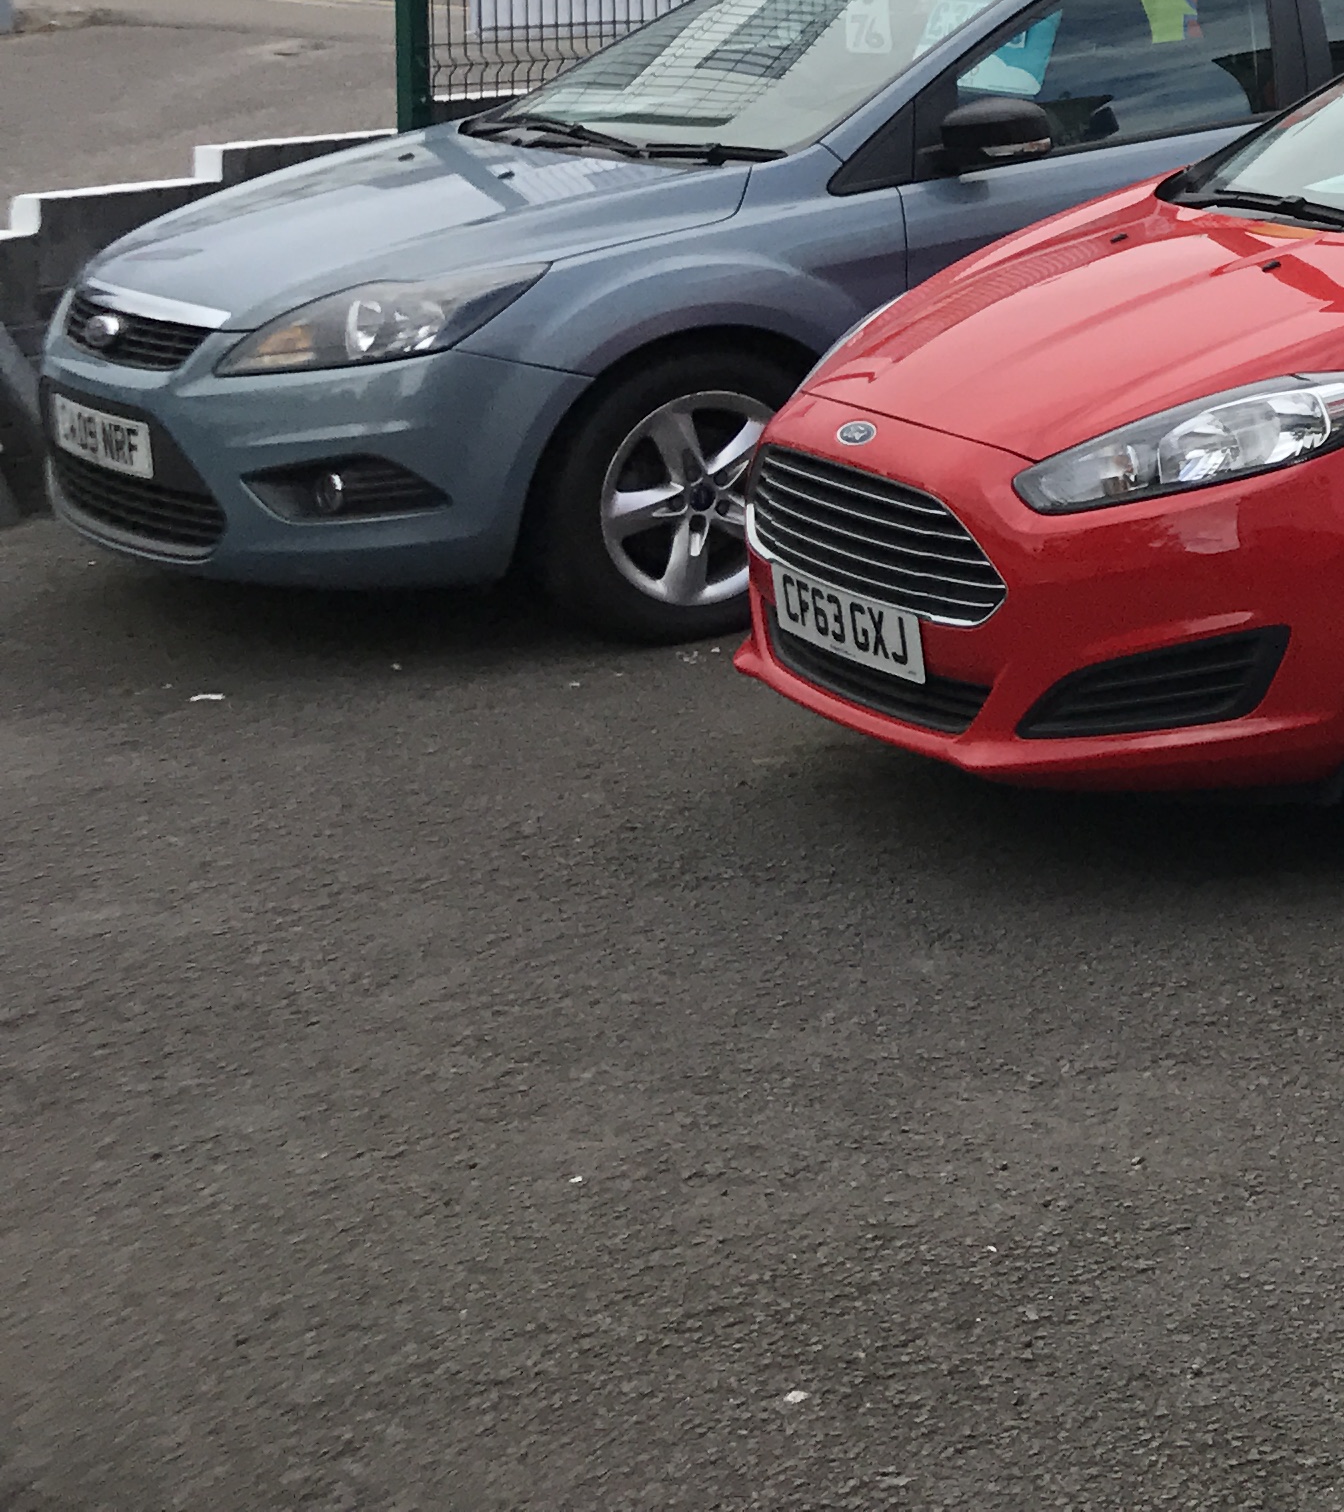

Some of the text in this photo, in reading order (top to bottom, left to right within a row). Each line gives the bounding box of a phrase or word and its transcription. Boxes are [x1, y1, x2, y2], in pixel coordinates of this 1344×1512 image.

[851, 14, 885, 48] 76
[782, 573, 908, 666] CF63 GXJ
